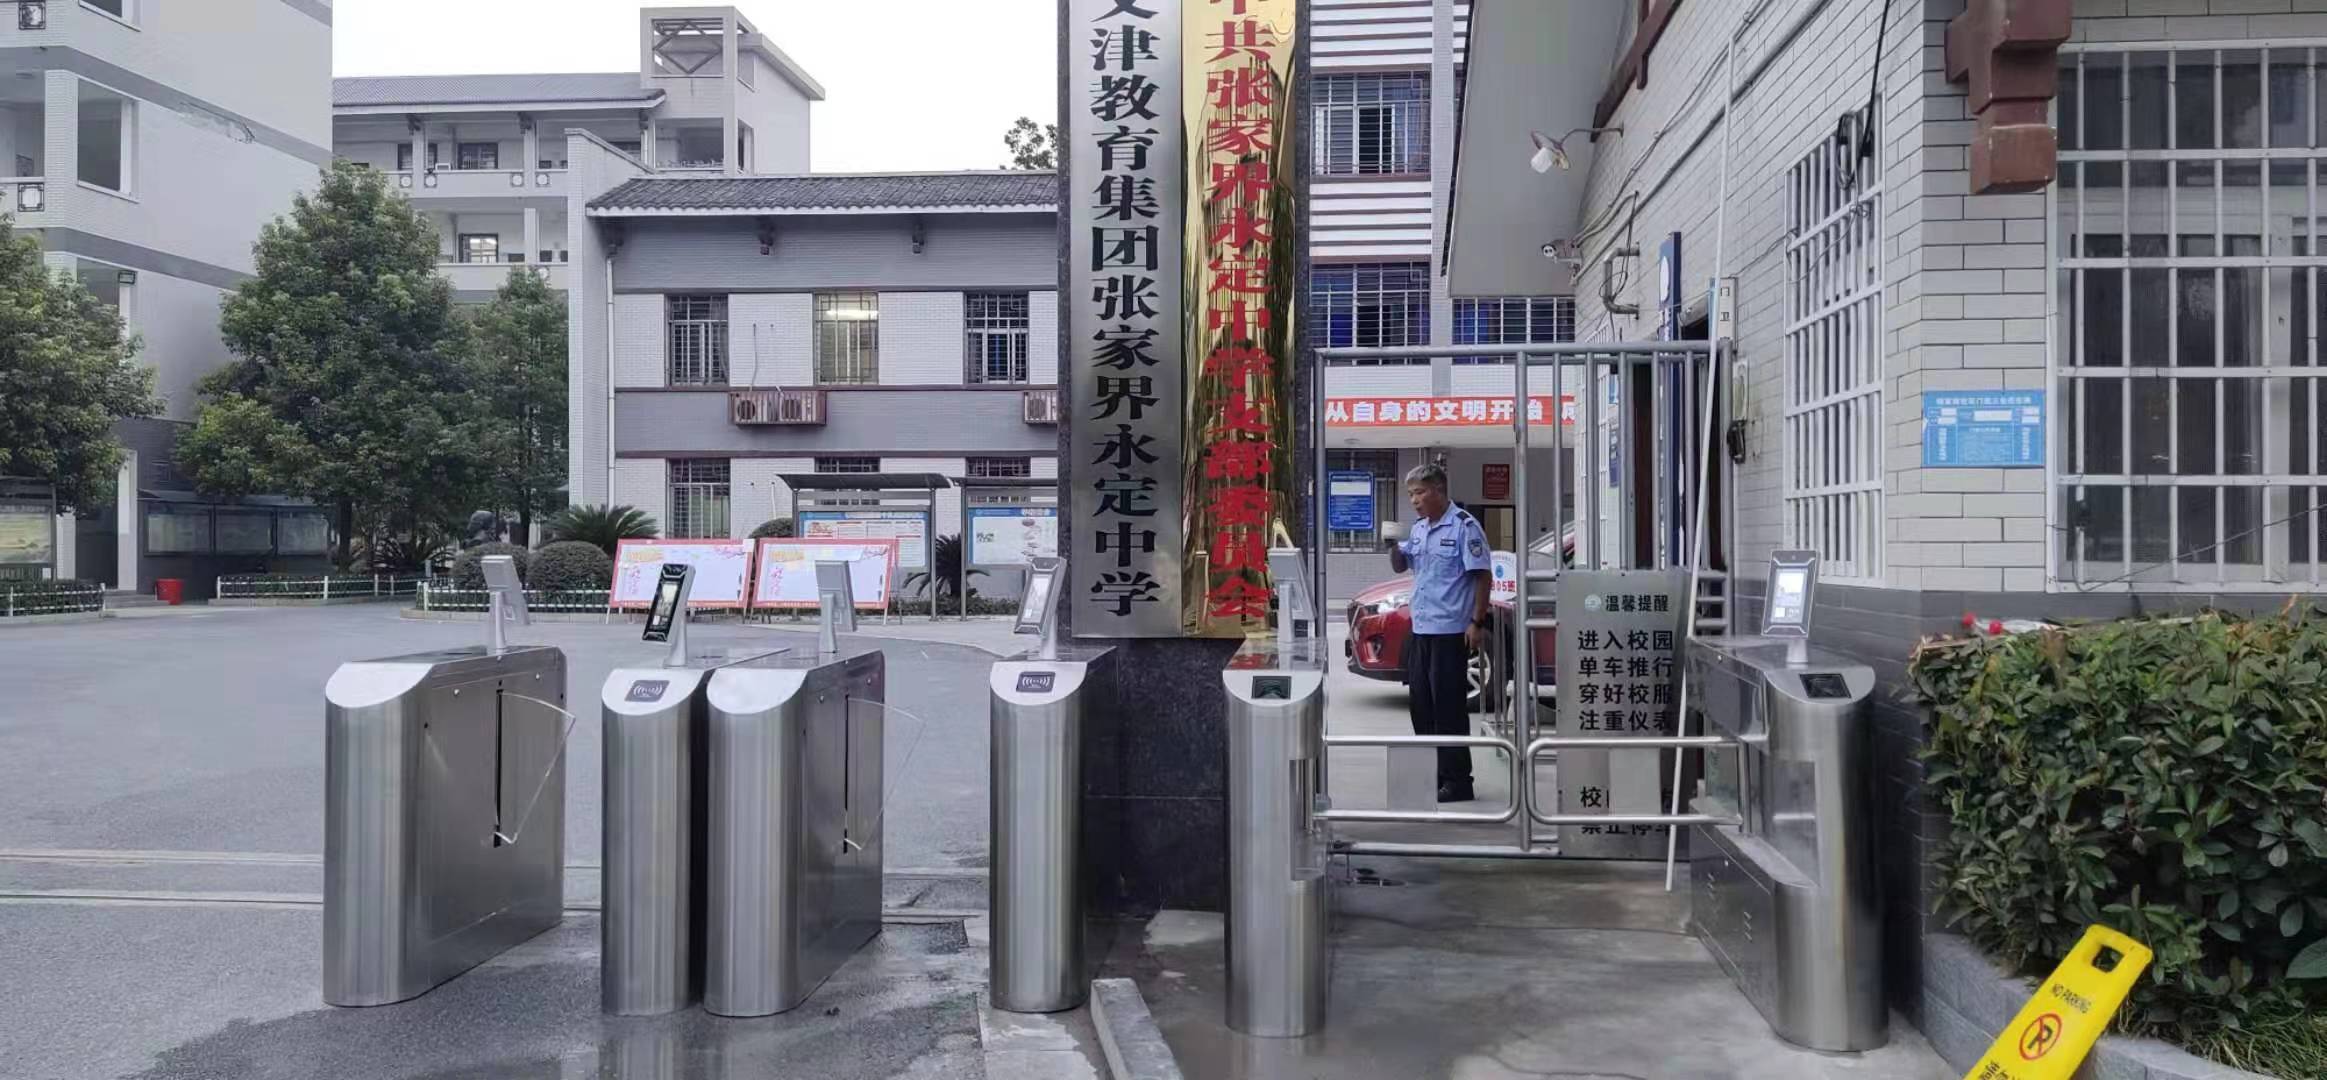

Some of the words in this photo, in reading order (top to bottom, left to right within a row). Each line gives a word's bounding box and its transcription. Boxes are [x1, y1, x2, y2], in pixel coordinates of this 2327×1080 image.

[1604, 594, 1669, 612] 温馨提醒
[1577, 629, 1673, 651] 进入校园
[1577, 656, 1675, 678] 单车推行
[1578, 682, 1674, 704] 穿好校服
[1578, 709, 1675, 731] 注重仪表
